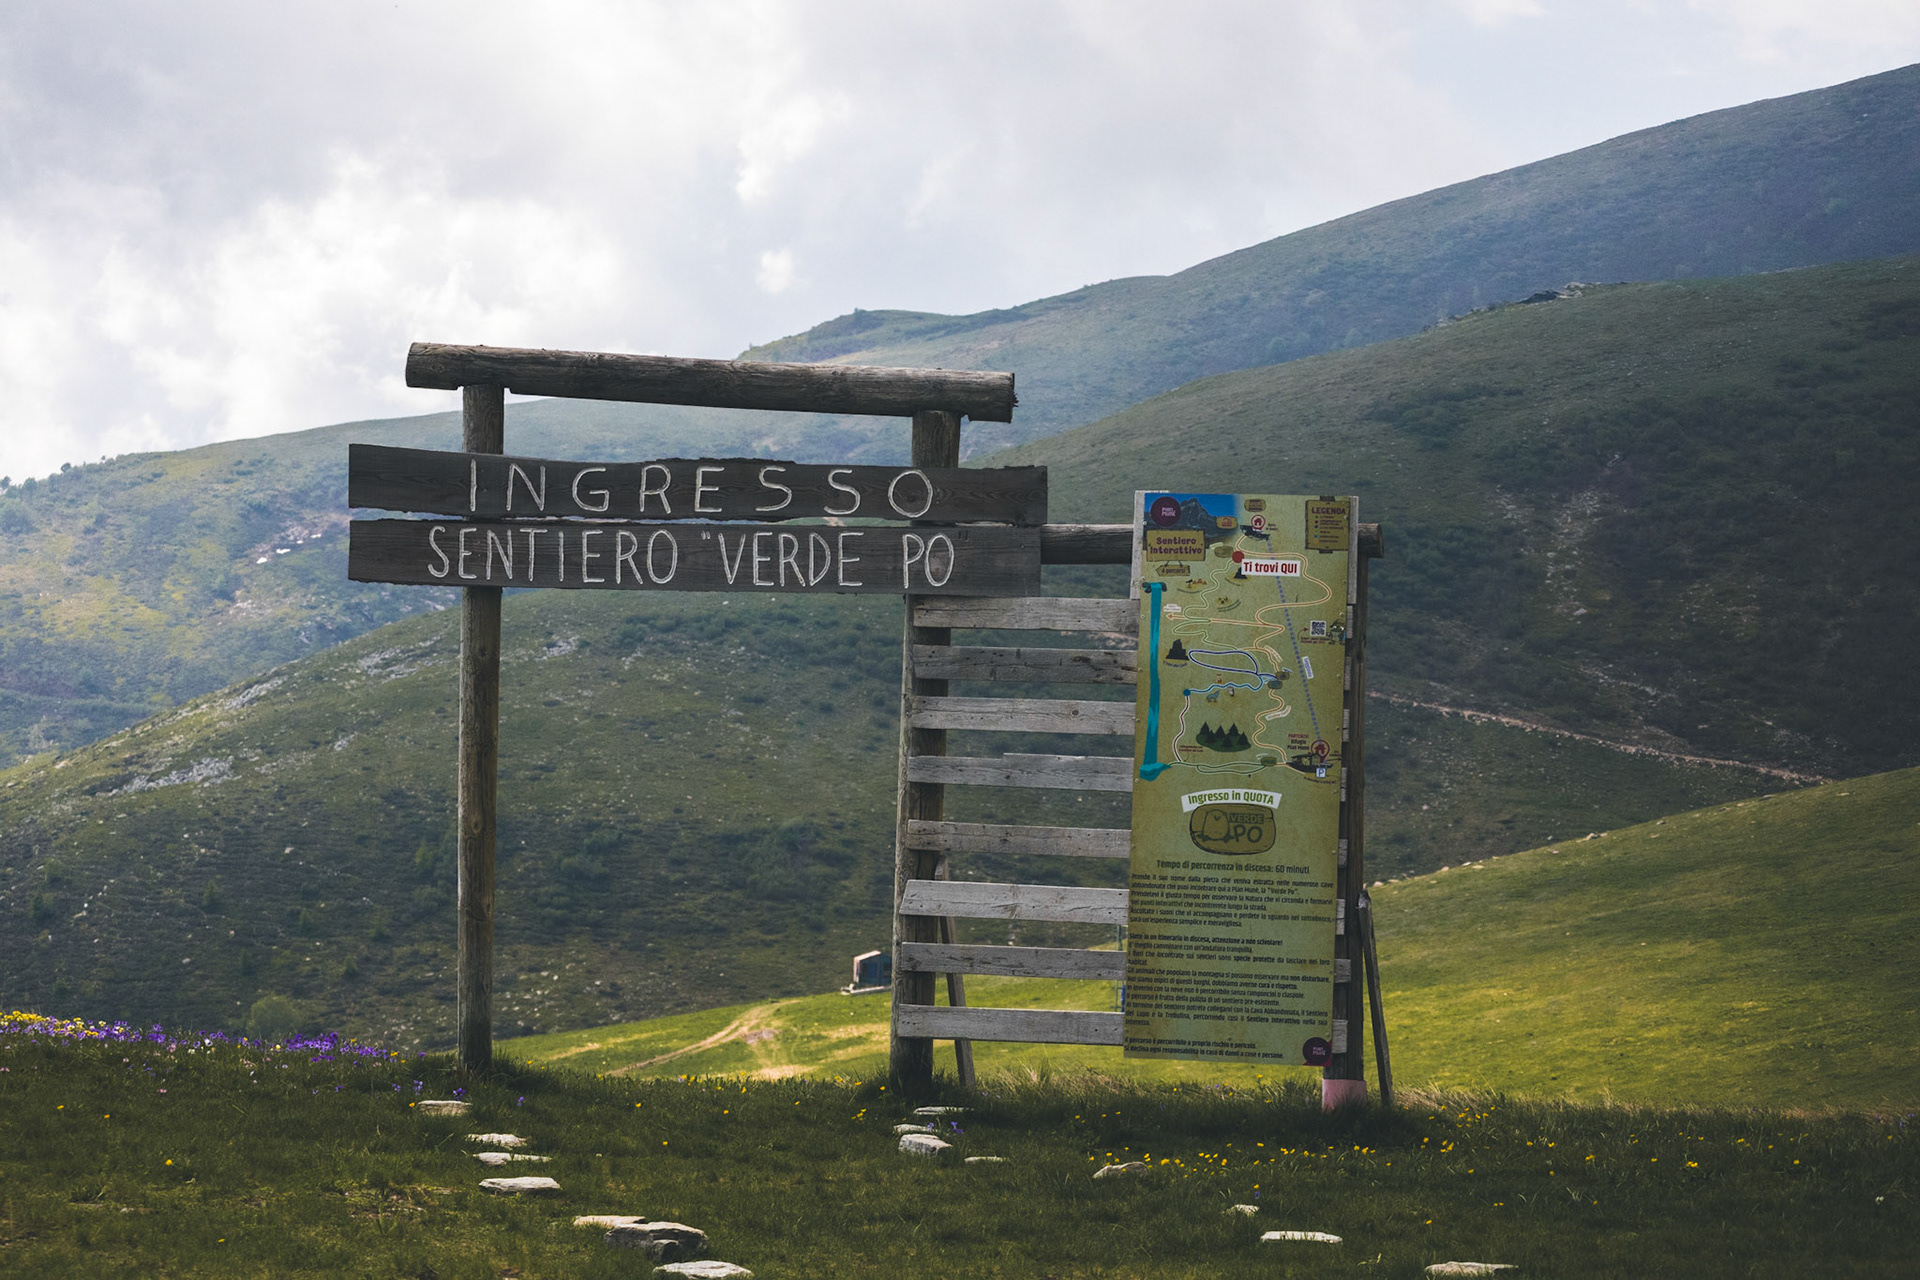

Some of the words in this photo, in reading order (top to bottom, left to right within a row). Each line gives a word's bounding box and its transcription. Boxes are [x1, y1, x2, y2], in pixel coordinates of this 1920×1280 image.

[469, 457, 934, 519] INGRESSO
[1311, 506, 1346, 514] LEGENDA
[1156, 536, 1196, 545] Sentiero
[1150, 546, 1202, 554] Interattivo
[428, 525, 678, 585] SENTIERO
[701, 531, 864, 588] "VERDE
[1243, 561, 1252, 572] Ti
[1255, 562, 1278, 573] trovi
[1281, 563, 1297, 574] QUI
[1319, 768, 1324, 777] P
[1188, 792, 1229, 804] Ingresso
[1232, 790, 1240, 801] in
[1243, 791, 1274, 804] QUOTA
[1230, 813, 1264, 824] VERDE
[1233, 824, 1263, 843] PO
[1157, 860, 1181, 870] Tempo
[1191, 863, 1234, 872] percorrenza
[1244, 864, 1274, 872] discesa:
[1286, 866, 1310, 874] minuti
[1193, 1013, 1225, 1021] percorrendo
[1264, 1008, 1300, 1017] Abbandonata,
